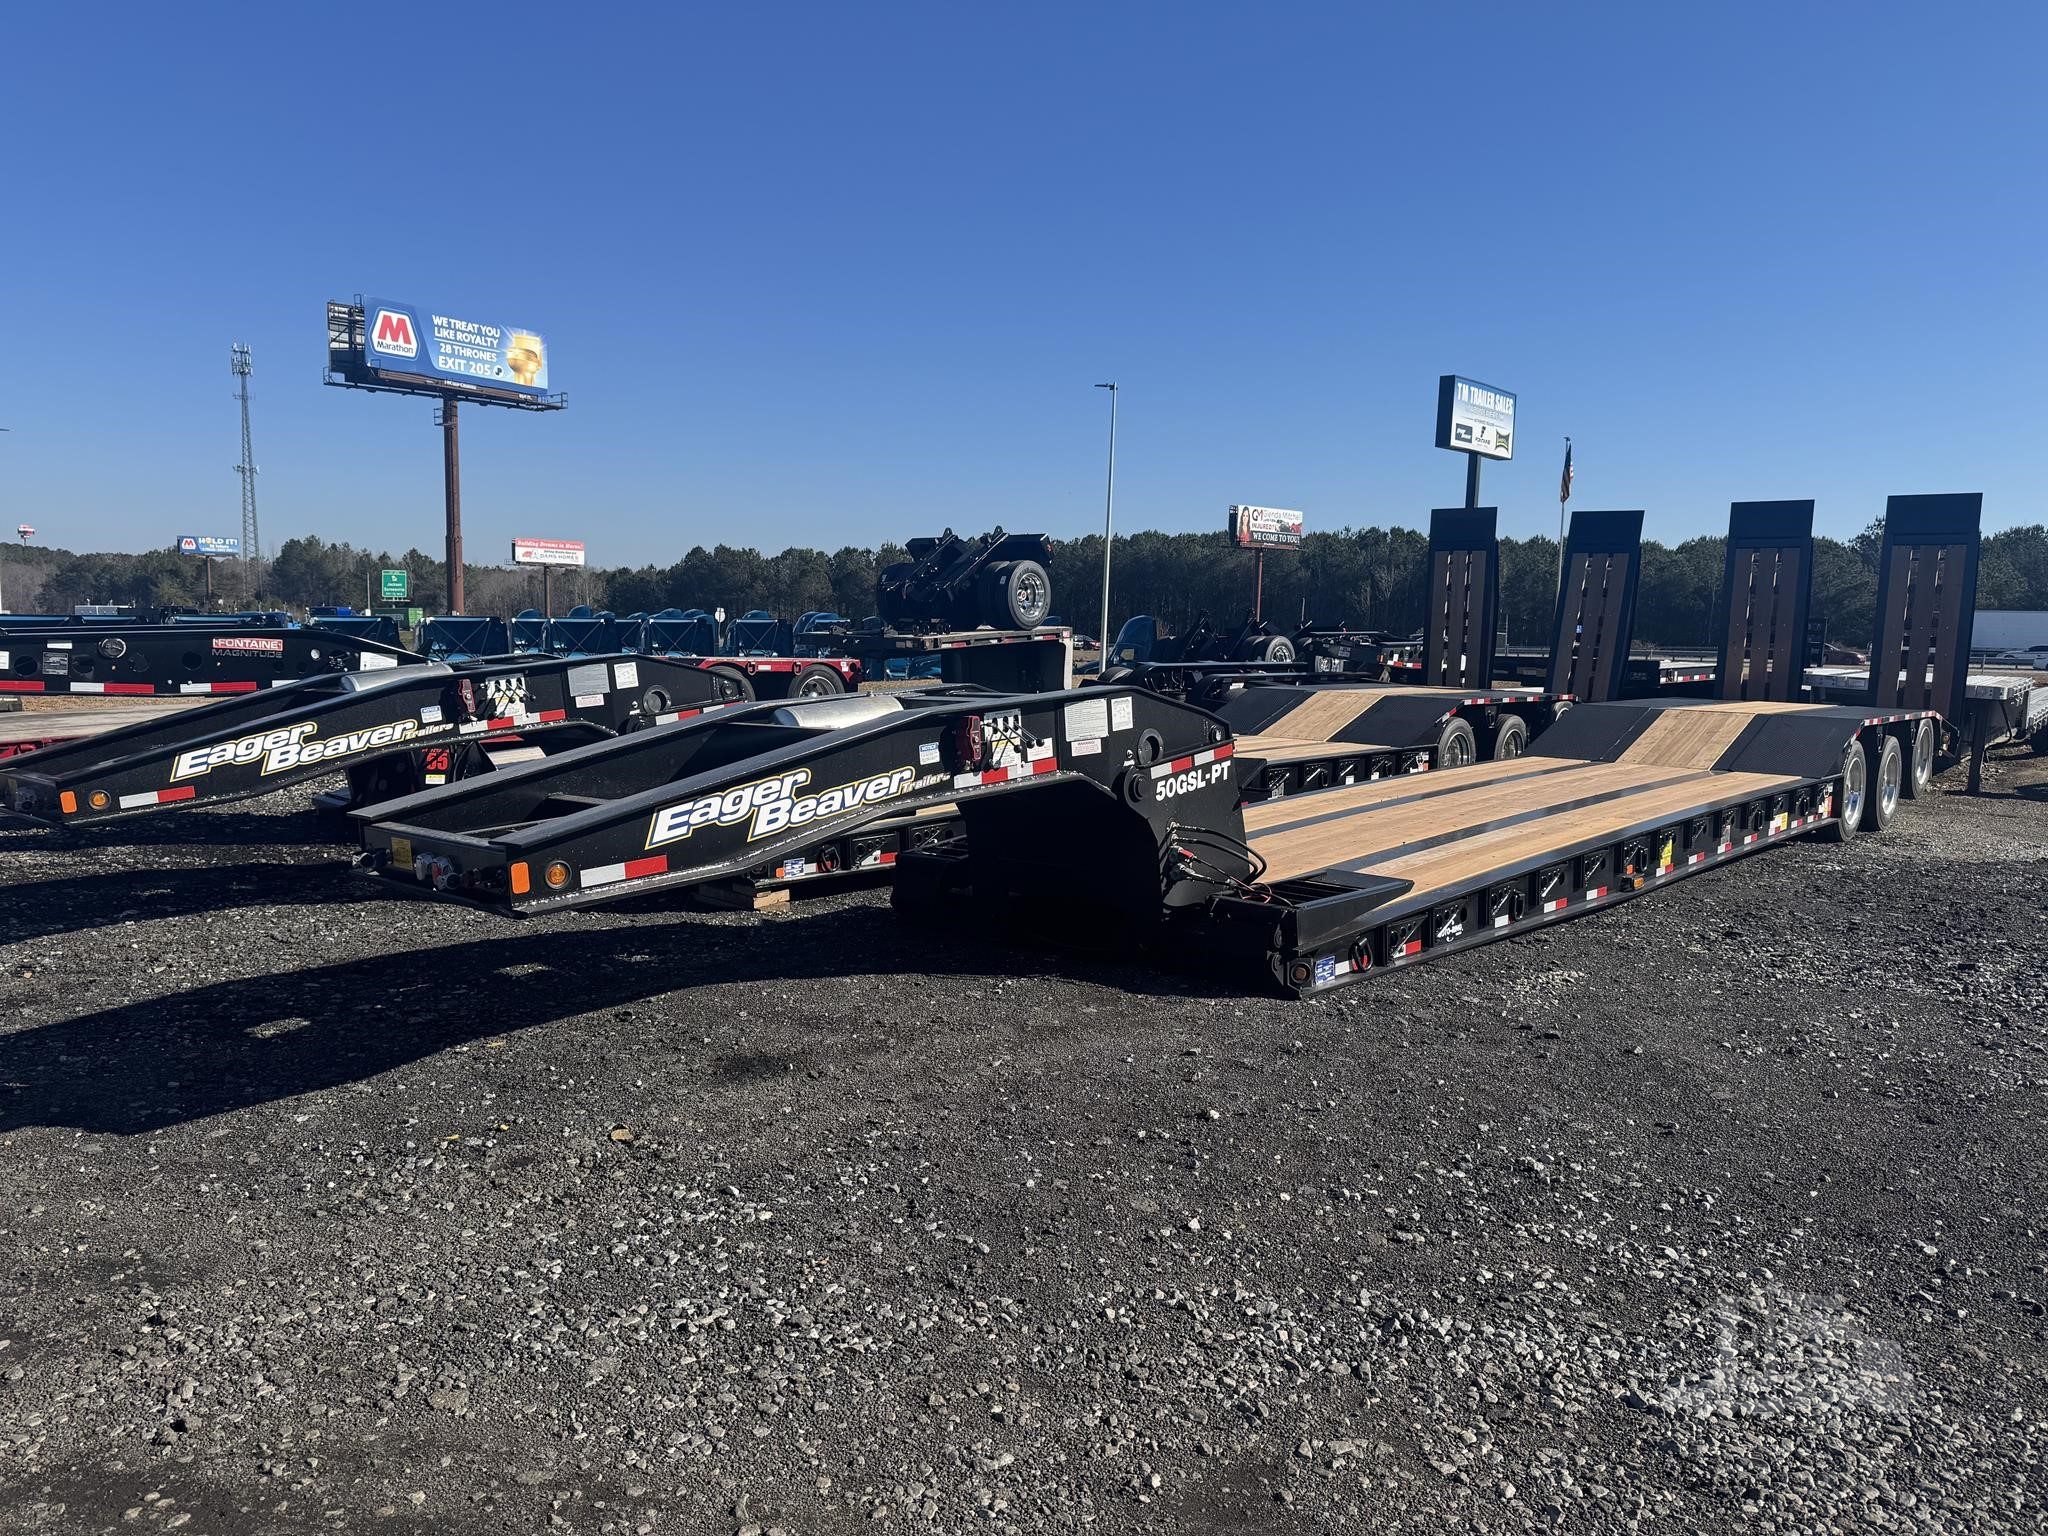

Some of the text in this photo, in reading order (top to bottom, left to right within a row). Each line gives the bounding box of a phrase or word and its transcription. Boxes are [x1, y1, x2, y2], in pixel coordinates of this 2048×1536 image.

[432, 315, 500, 338] WE TREAT YOU
[435, 326, 499, 348] LIKE ROYALTY
[377, 340, 414, 354] Marathon
[440, 343, 497, 362] 28 THRONES
[438, 355, 467, 372] EXIT
[469, 361, 491, 376] 205
[1470, 386, 1495, 410] TRAILER
[1495, 393, 1513, 416] SALES
[199, 537, 225, 545] HOLD
[1253, 532, 1262, 541] WE
[1262, 533, 1279, 542] COME
[1279, 535, 1287, 543] TO
[211, 648, 283, 659] MAGNITUDE
[218, 639, 279, 649] FONTAINE
[169, 721, 318, 783] Eager
[260, 718, 455, 777] Beaver Trailers
[1155, 760, 1232, 801] 50GSL-PT
[644, 767, 812, 850] Eager
[747, 765, 916, 843] Beaver
